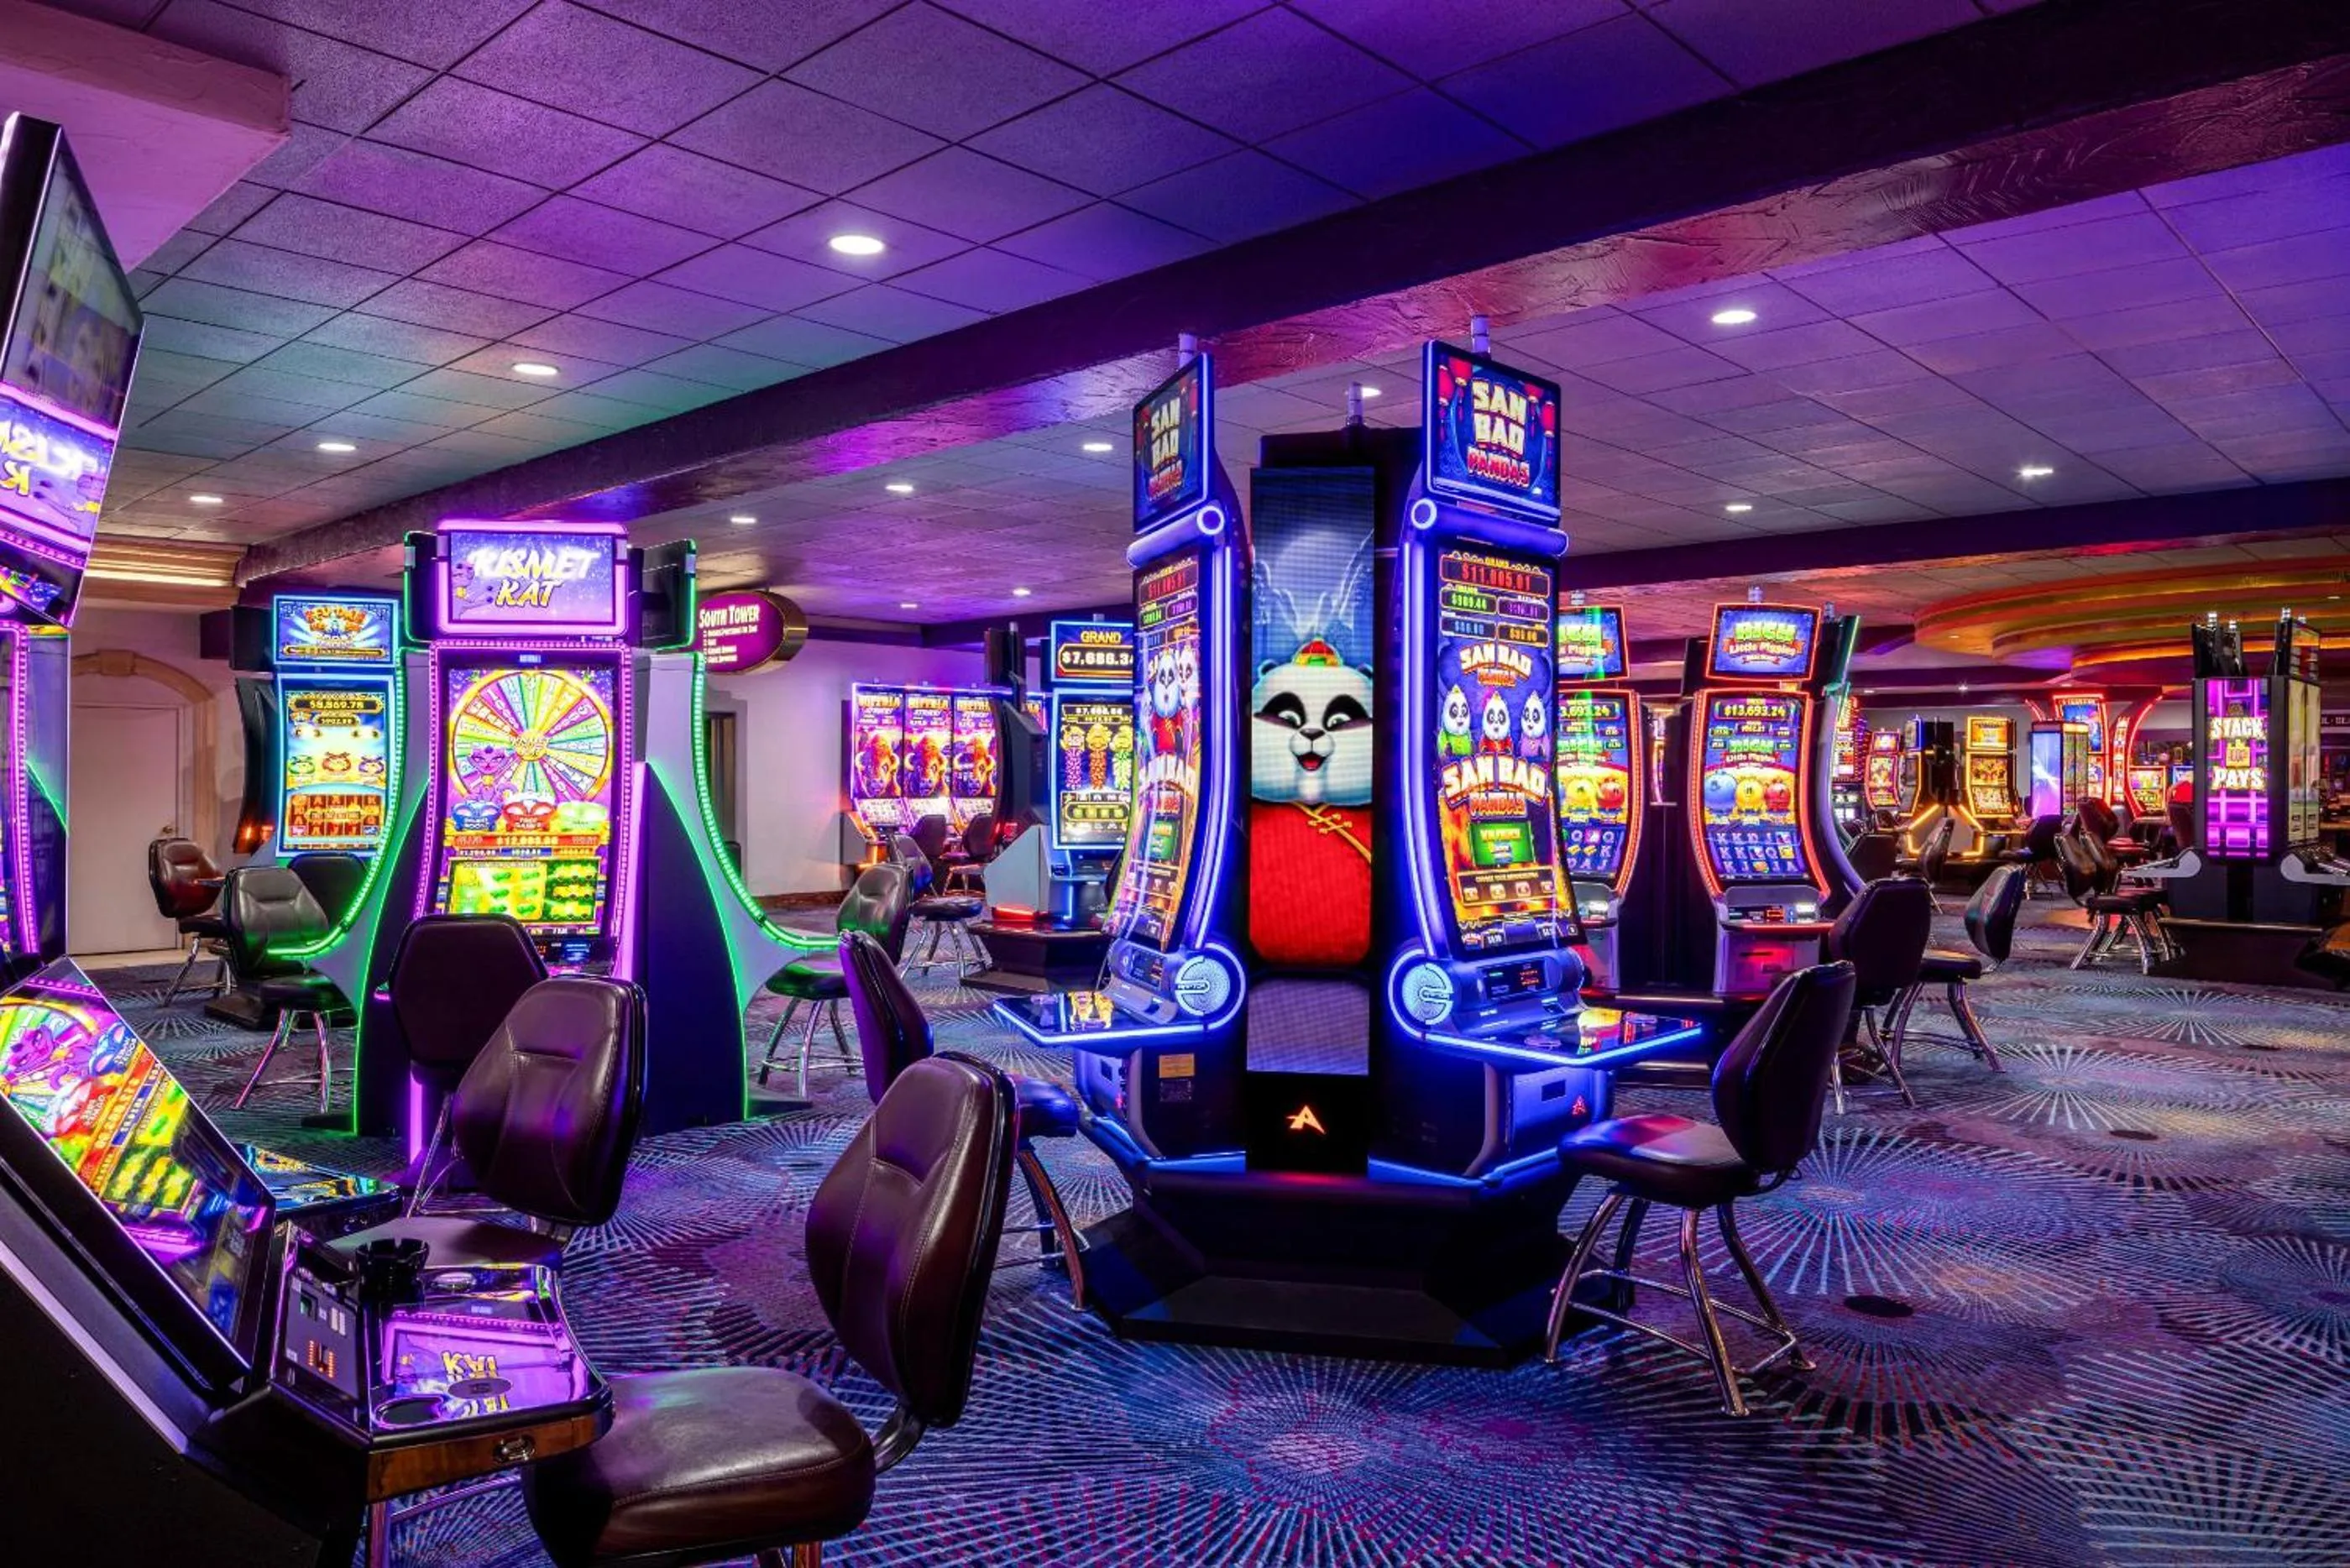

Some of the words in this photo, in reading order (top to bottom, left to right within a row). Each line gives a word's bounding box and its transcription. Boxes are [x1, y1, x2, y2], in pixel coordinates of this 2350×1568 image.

[1473, 380, 1526, 425] SAN
[1474, 411, 1525, 454] BAO
[1467, 446, 1530, 488] PANDAS
[467, 546, 602, 580] KISMET
[495, 578, 565, 608] KAT
[1081, 630, 1122, 643] GRAND
[1459, 642, 1494, 673] SAN
[2210, 717, 2266, 740] STACK
[1442, 755, 1494, 808] SAN
[1498, 755, 1547, 806] BAO
[2211, 766, 2267, 791] PAYS
